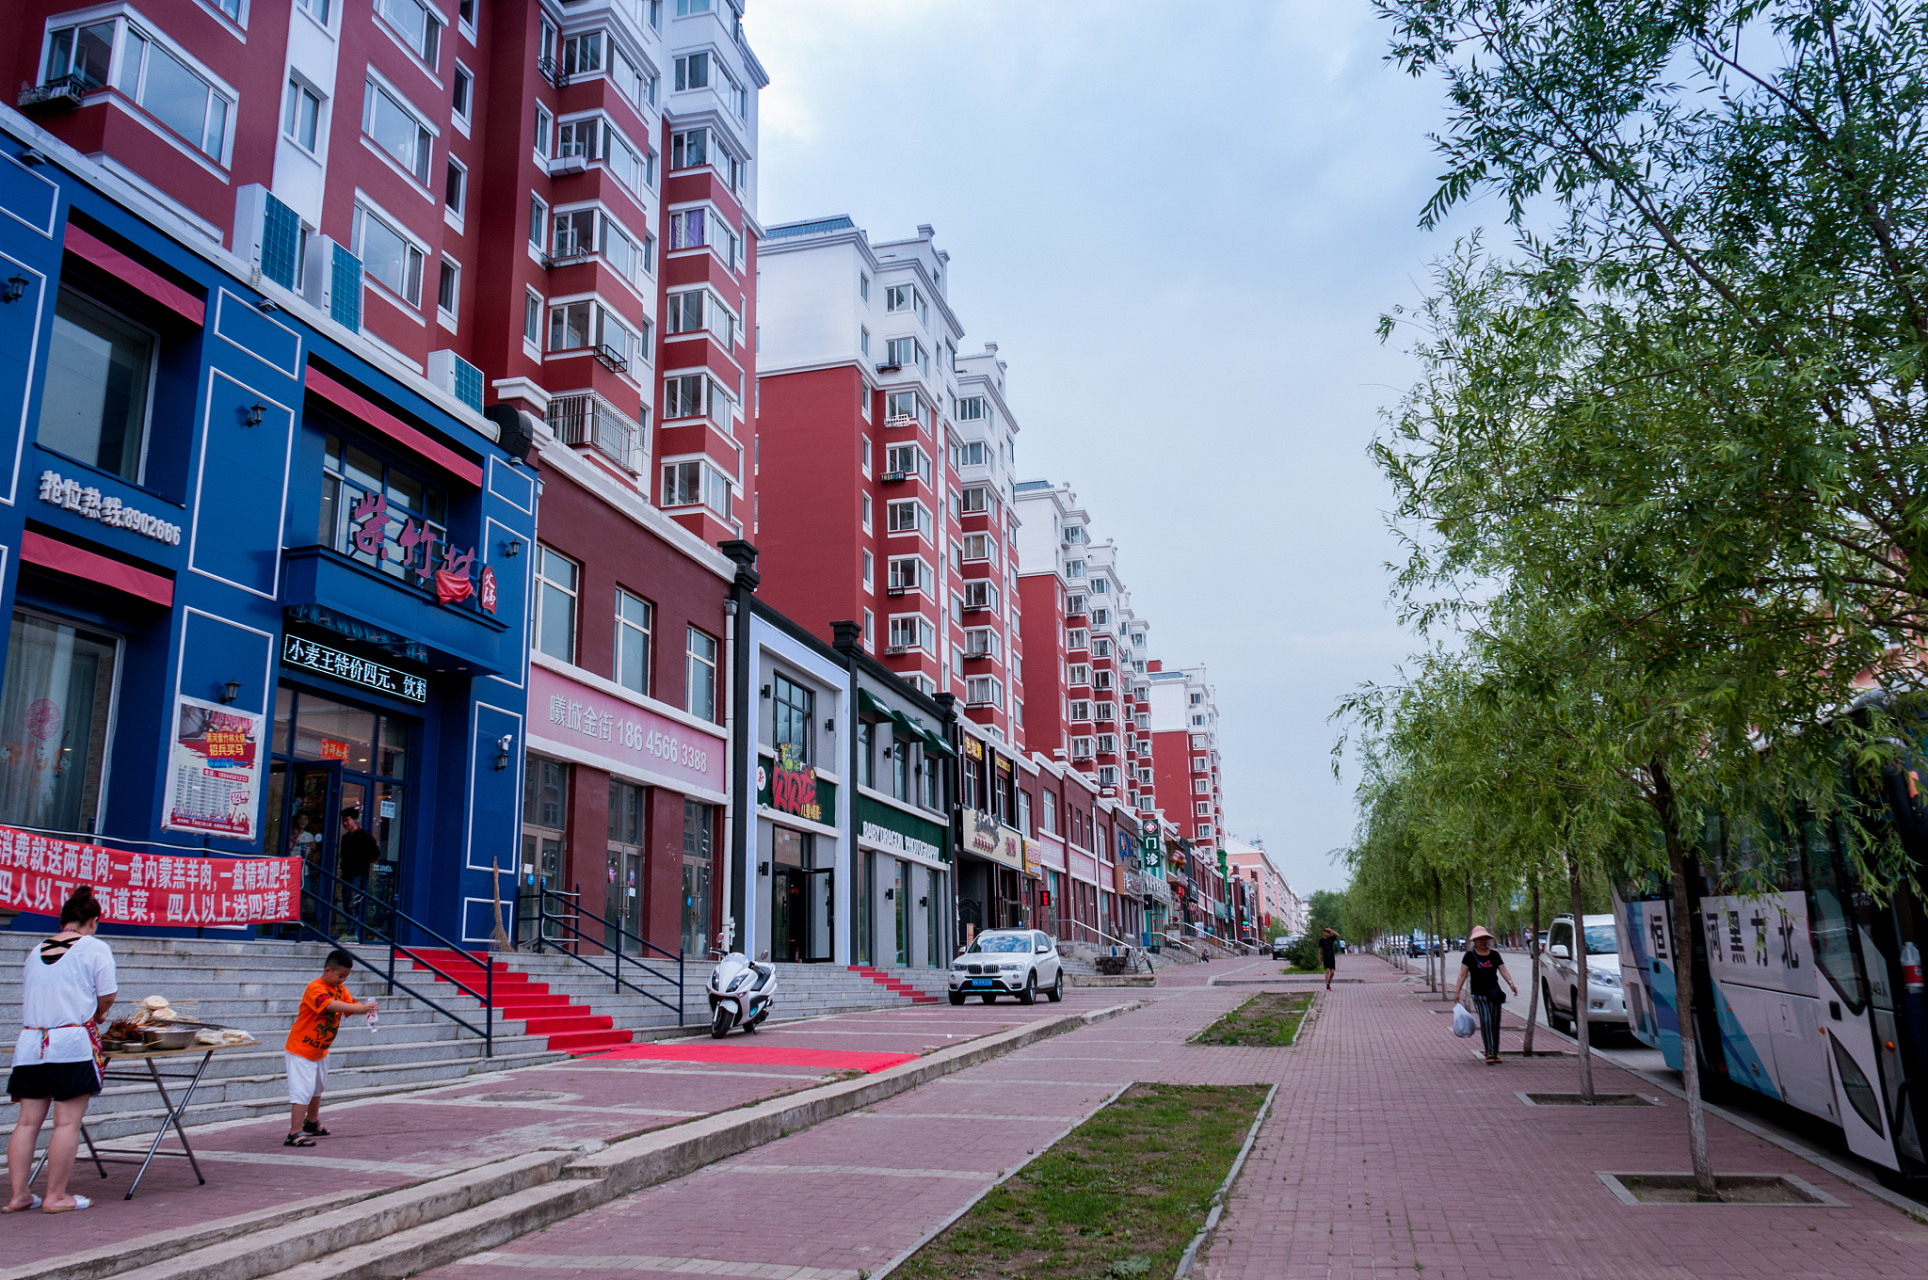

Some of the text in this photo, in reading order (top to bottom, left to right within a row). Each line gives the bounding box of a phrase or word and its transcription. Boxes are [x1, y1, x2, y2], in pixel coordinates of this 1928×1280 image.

[209, 744, 244, 757] 招兵买马
[616, 718, 643, 751] 186
[646, 730, 679, 764] 4566
[682, 743, 707, 773] 3388
[863, 821, 880, 842] BABY
[1145, 836, 1159, 866] 门诊
[0, 869, 290, 924] 四人以下两道菜,四人以上送四道菜
[302, 1035, 321, 1048] SPACE
